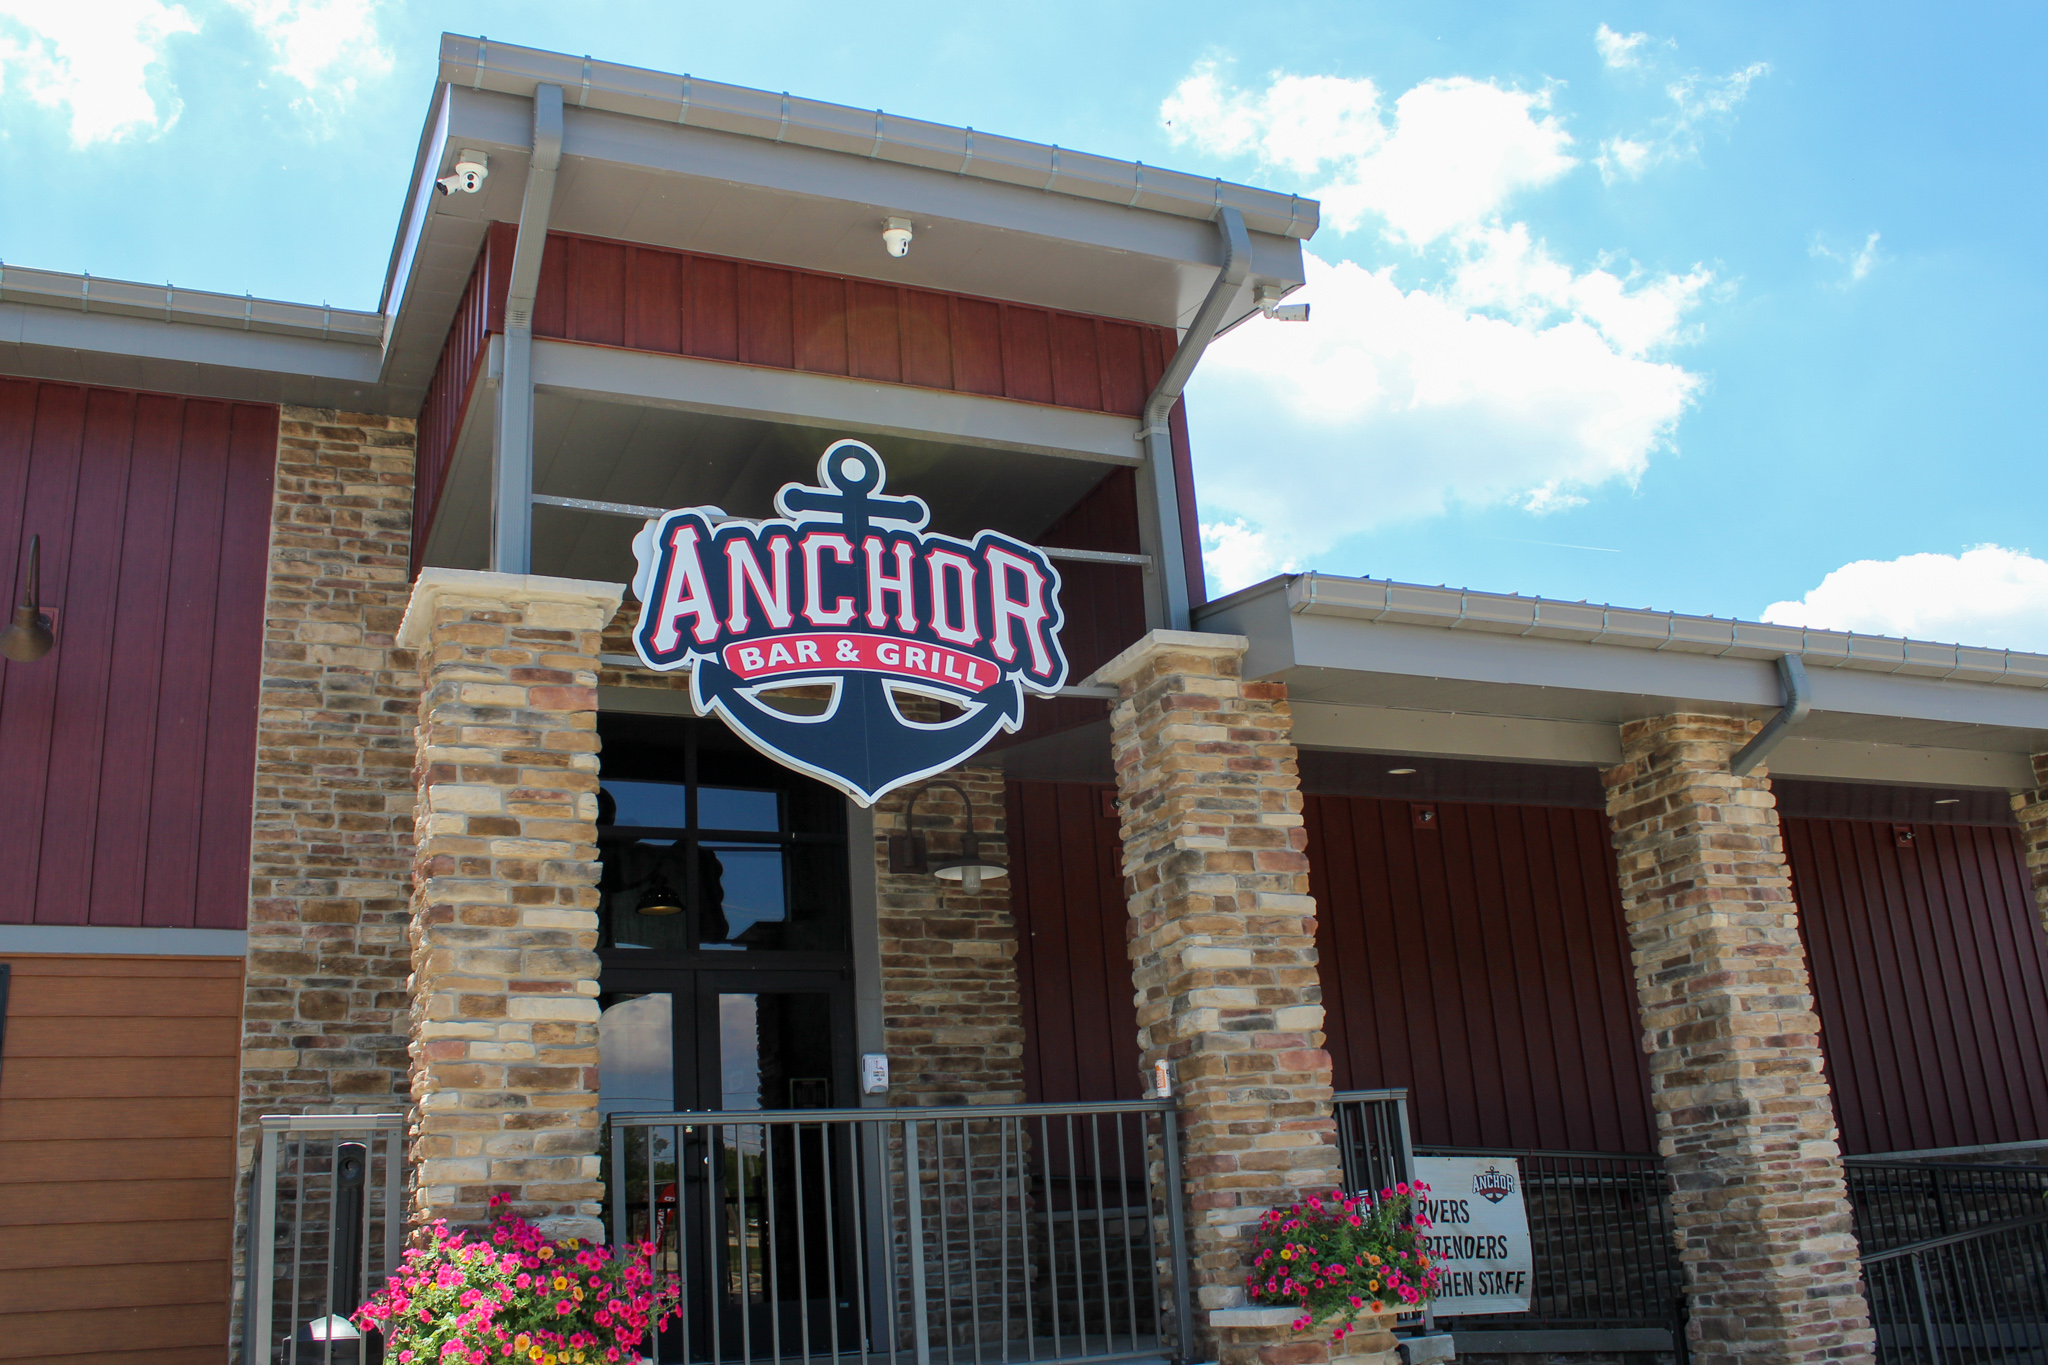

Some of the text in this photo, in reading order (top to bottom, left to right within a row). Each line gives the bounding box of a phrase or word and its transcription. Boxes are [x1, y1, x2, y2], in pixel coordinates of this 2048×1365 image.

[651, 523, 1055, 678] ANCHOR
[738, 639, 984, 687] BAR & GRILL
[1472, 1174, 1515, 1194] ANCHOR
[1417, 1199, 1470, 1224] RVERS
[1423, 1235, 1508, 1260] RTENDERS
[1478, 1270, 1526, 1296] STAFF
